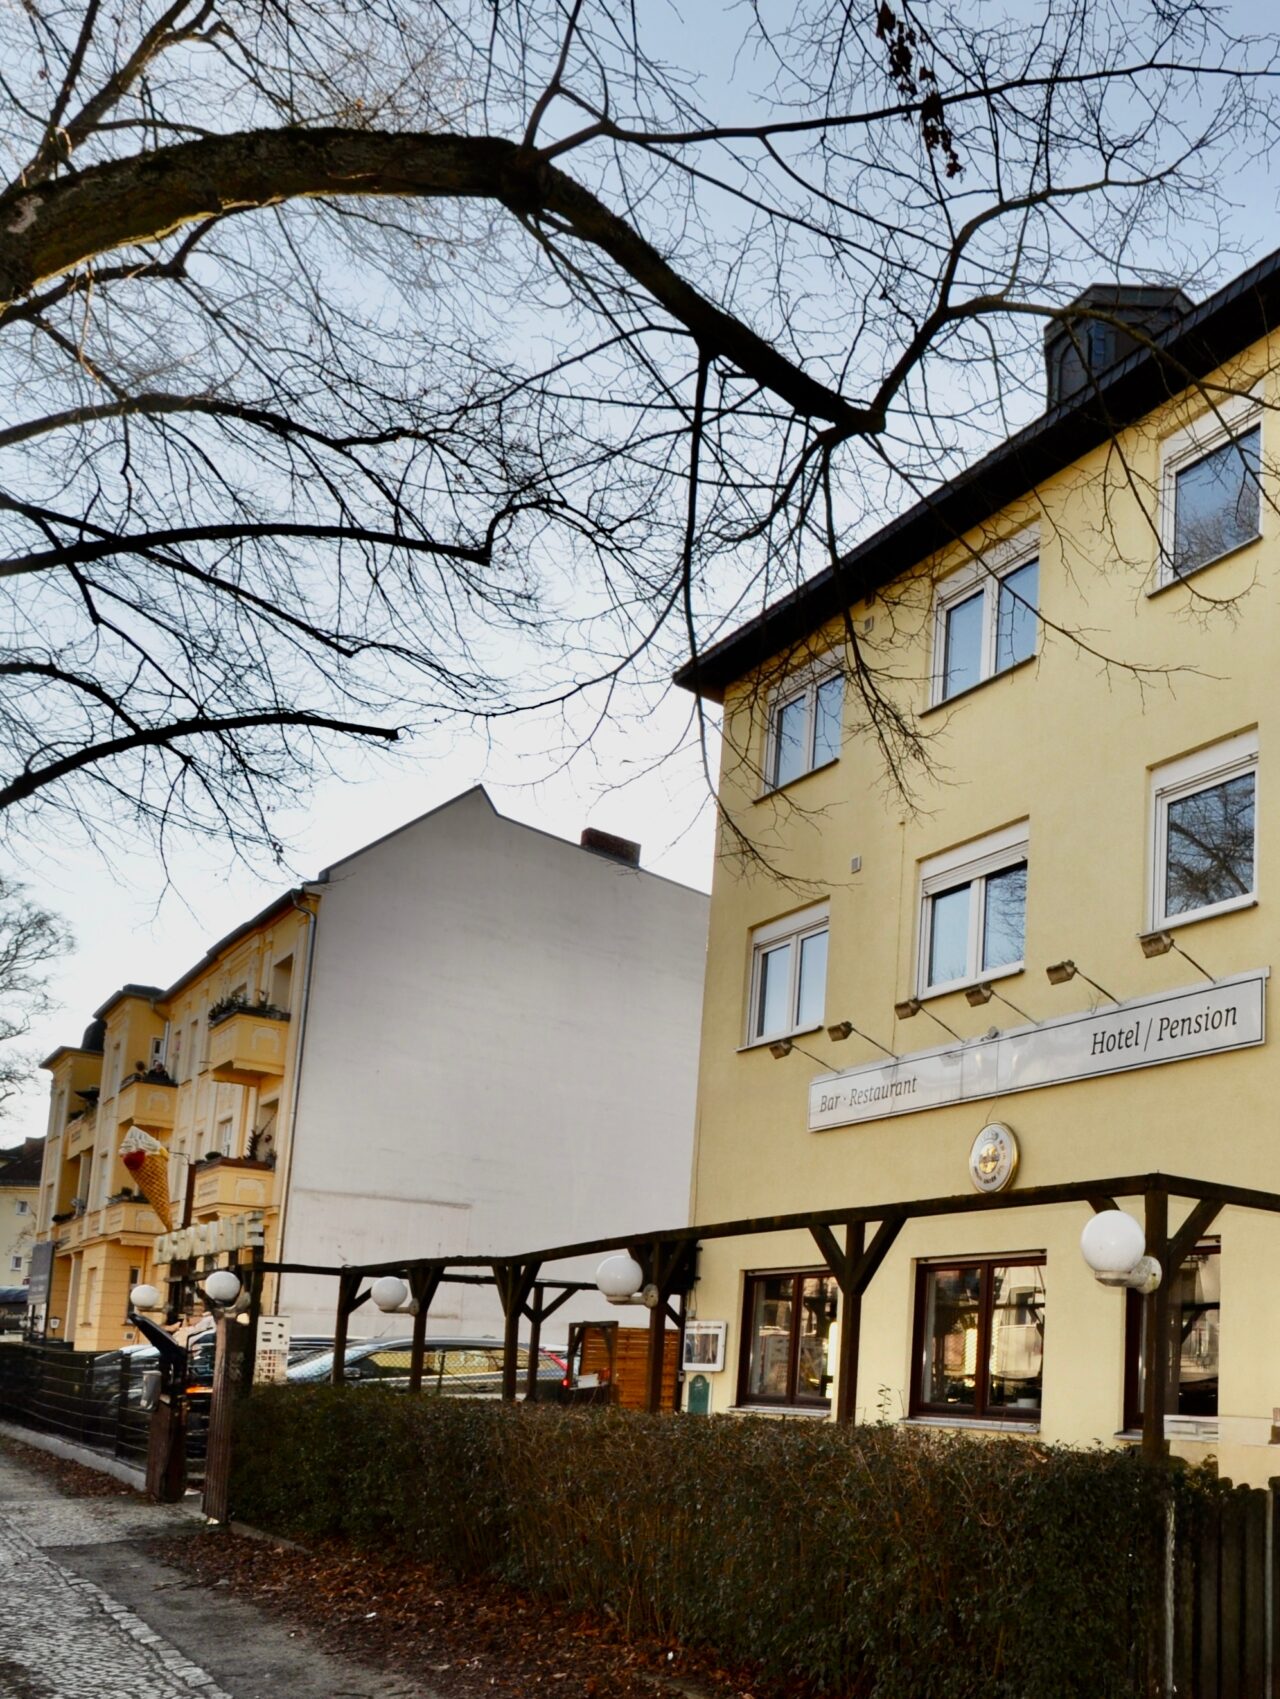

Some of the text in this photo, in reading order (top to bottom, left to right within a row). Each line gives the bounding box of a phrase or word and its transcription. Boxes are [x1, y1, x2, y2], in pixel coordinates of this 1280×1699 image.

[1091, 1020, 1140, 1055] Hotel
[1157, 1005, 1238, 1042] Pension
[820, 1075, 918, 1112] Bar Restaurant
